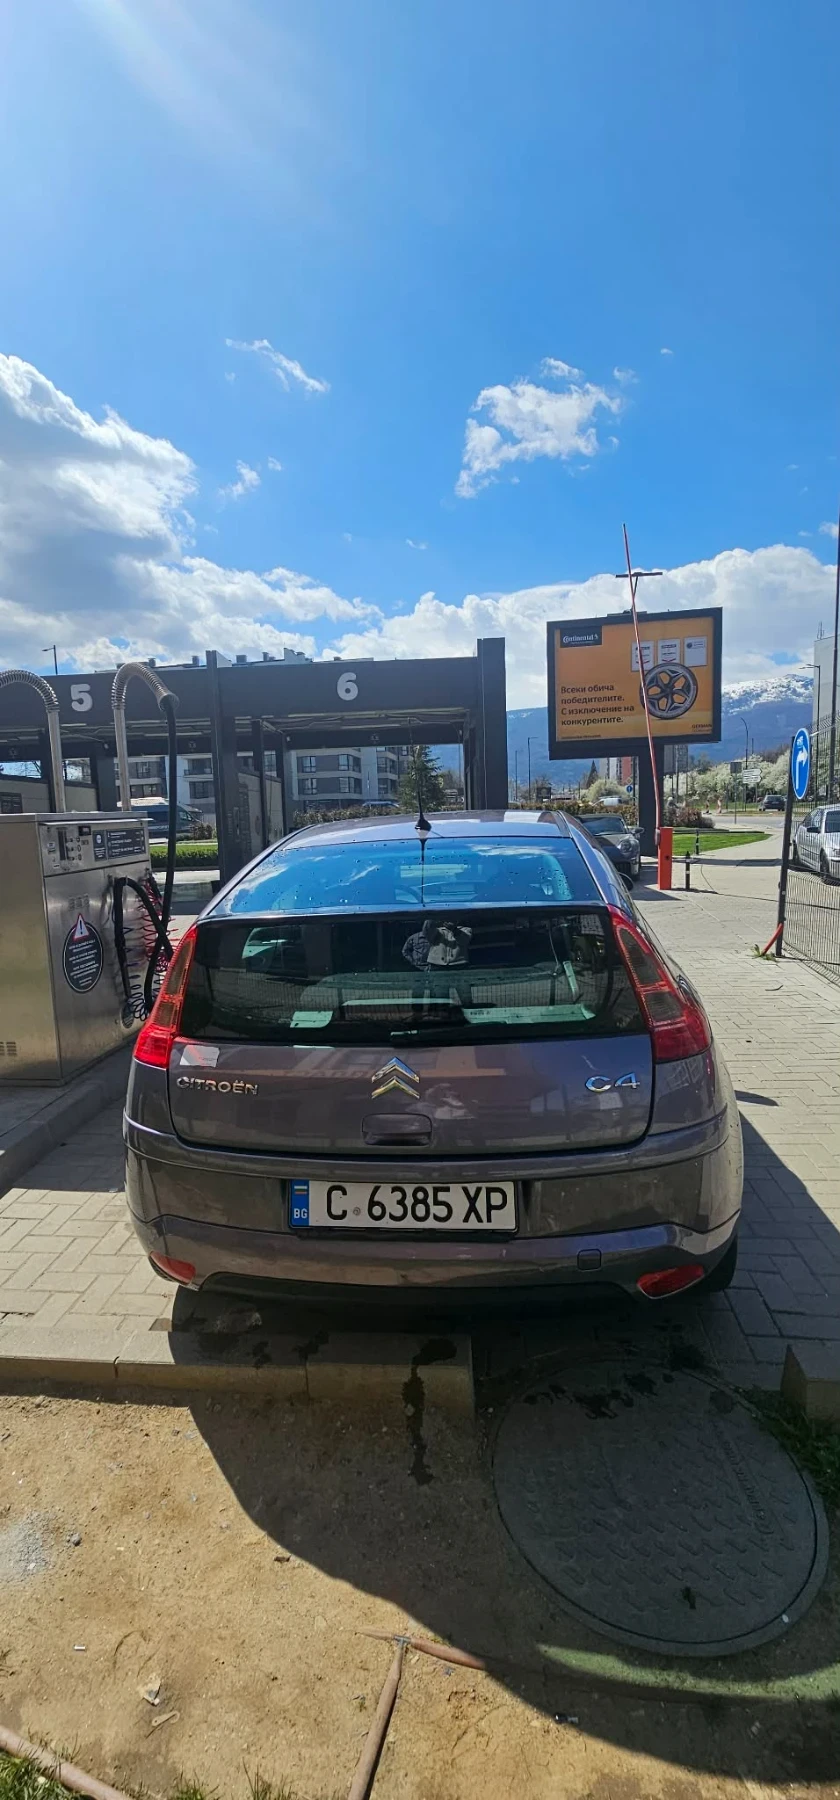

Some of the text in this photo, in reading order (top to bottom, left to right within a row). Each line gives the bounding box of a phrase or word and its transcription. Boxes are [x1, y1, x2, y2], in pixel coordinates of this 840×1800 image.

[336, 672, 359, 701] 6
[561, 684, 615, 694] Всеки обича
[70, 684, 93, 712] 5
[561, 695, 625, 704] победителите.
[568, 706, 622, 715] изключение
[561, 716, 624, 726] конкурентите.
[176, 1076, 259, 1095] CITROËN
[585, 1073, 641, 1093] C4
[326, 1184, 508, 1224] C 6385 XP
[293, 1208, 308, 1220] BG
